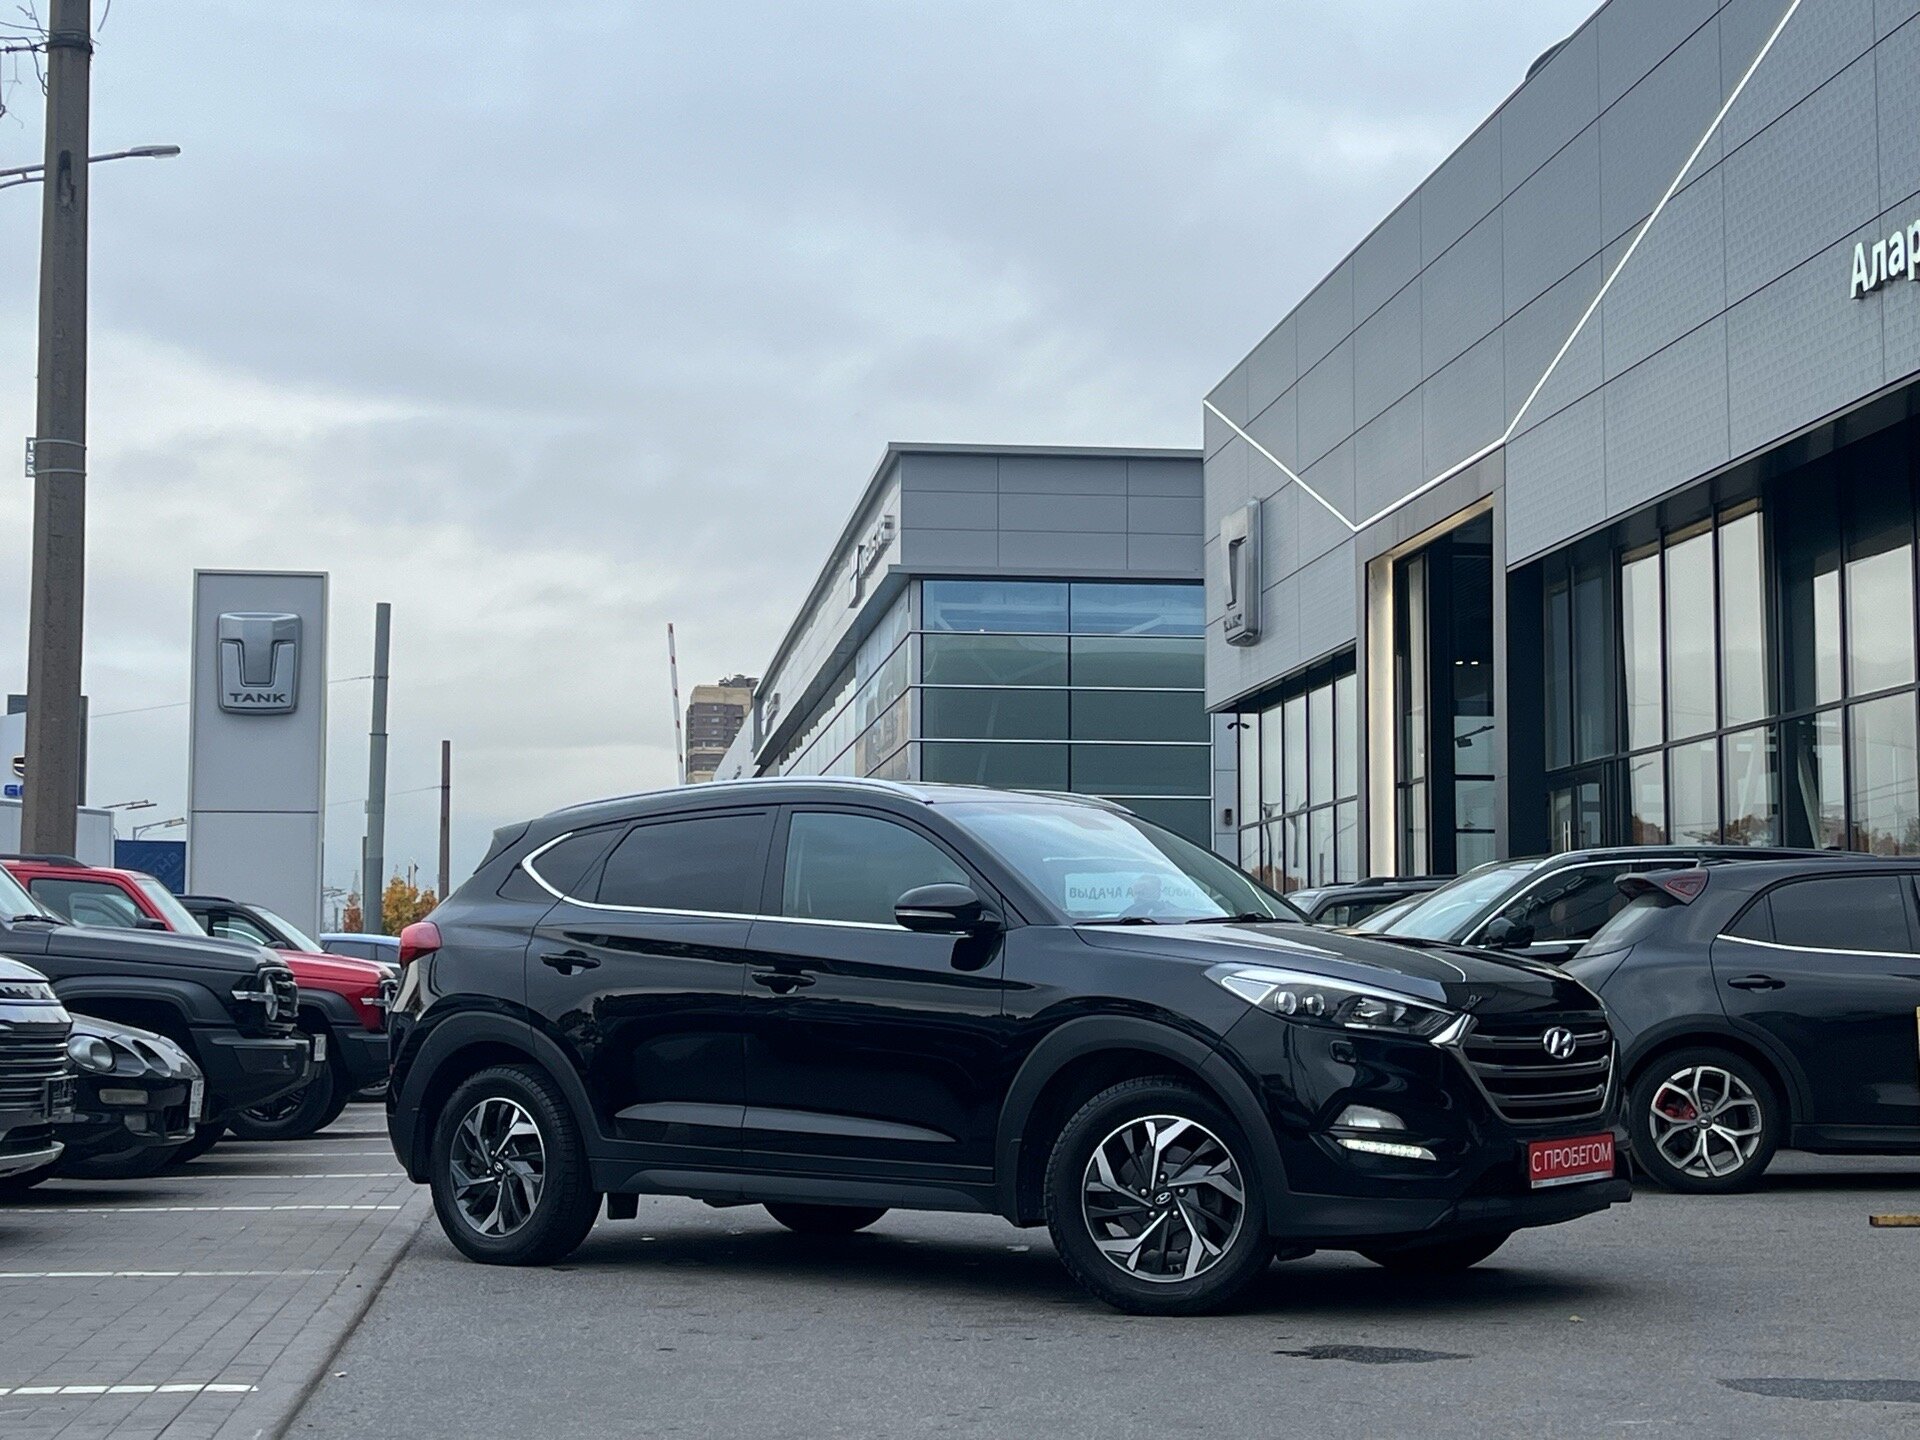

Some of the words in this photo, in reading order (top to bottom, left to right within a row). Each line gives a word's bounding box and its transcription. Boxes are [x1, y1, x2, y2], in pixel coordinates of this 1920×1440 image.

[26, 440, 36, 475] 155
[229, 693, 286, 703] TANK
[1069, 886, 1122, 900] ВЫДАЧА
[1532, 1152, 1541, 1172] С
[1544, 1142, 1612, 1170] ПРОБЕГОМ
